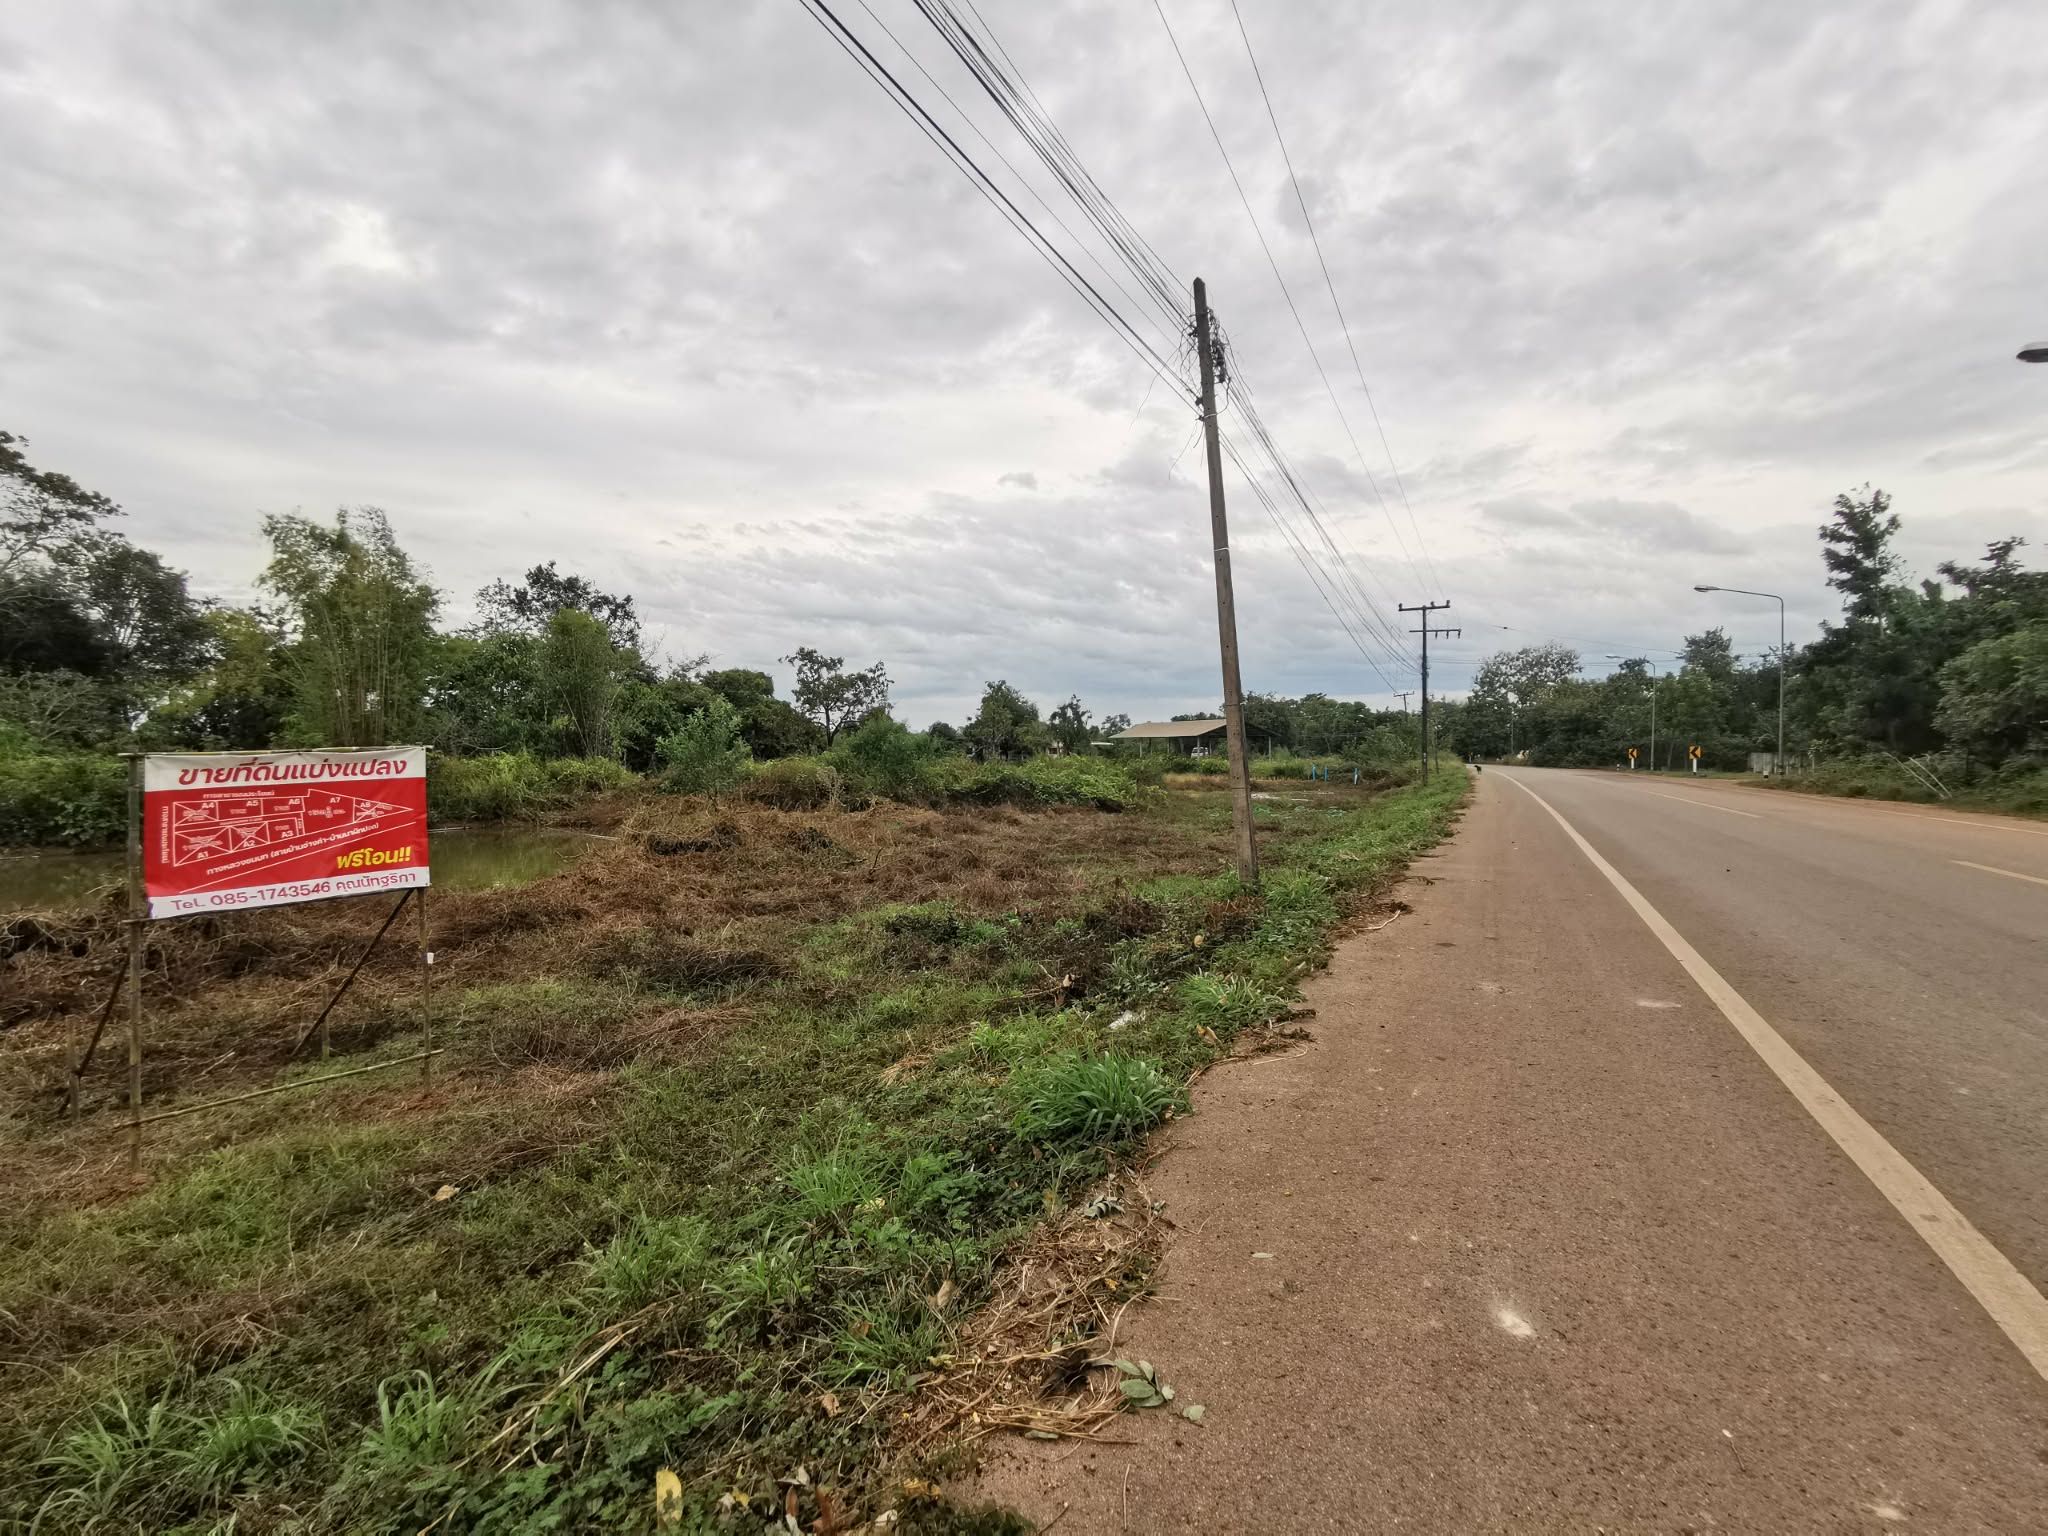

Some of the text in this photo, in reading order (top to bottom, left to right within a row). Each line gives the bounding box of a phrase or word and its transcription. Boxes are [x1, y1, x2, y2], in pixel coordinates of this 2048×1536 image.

[179, 758, 407, 785] ขายที่ดินแบ่งแปลง
[246, 799, 259, 807] A5
[288, 797, 301, 806] A6
[329, 796, 340, 804] A7
[201, 801, 215, 810] A4
[280, 830, 294, 838] A3
[243, 839, 255, 848] A2
[197, 850, 209, 860] A1
[336, 846, 411, 869] ฟรีโอน!!
[171, 899, 206, 911] Tel.
[210, 881, 331, 906] 085-1743546
